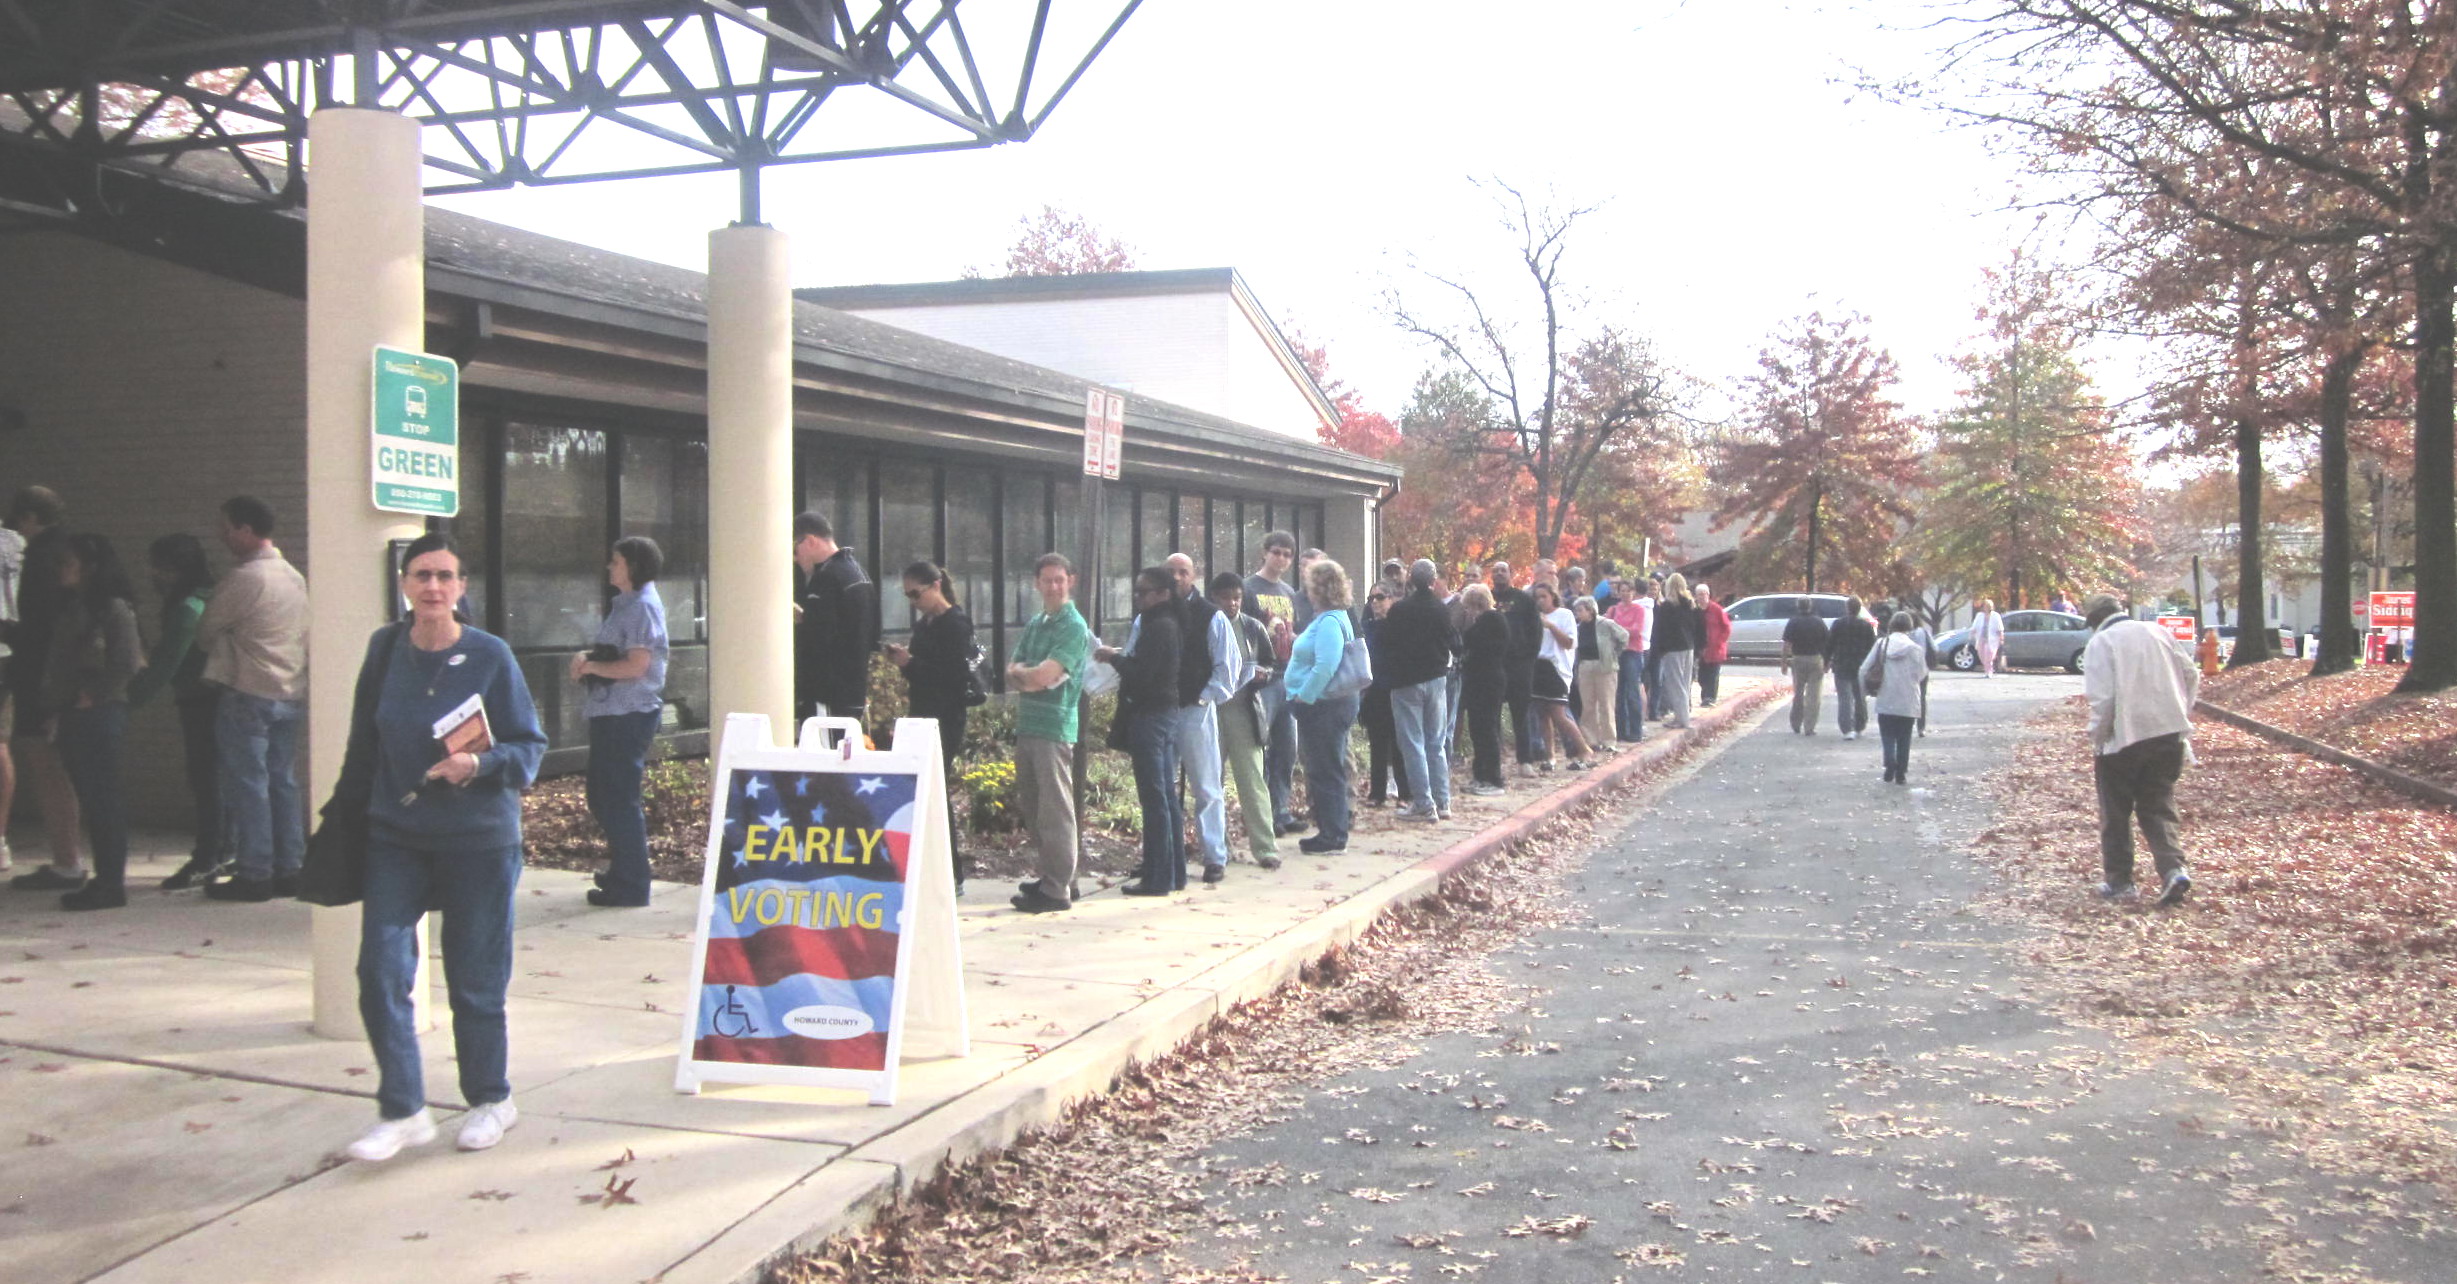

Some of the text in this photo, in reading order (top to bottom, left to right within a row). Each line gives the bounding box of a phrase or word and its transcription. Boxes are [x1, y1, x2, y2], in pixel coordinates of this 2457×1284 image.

[402, 422, 431, 435] STOP
[378, 446, 453, 479] GREEN
[745, 824, 885, 865] EARLY
[728, 887, 884, 929] VOTING
[794, 1016, 859, 1026] HOWARD COUNTY
